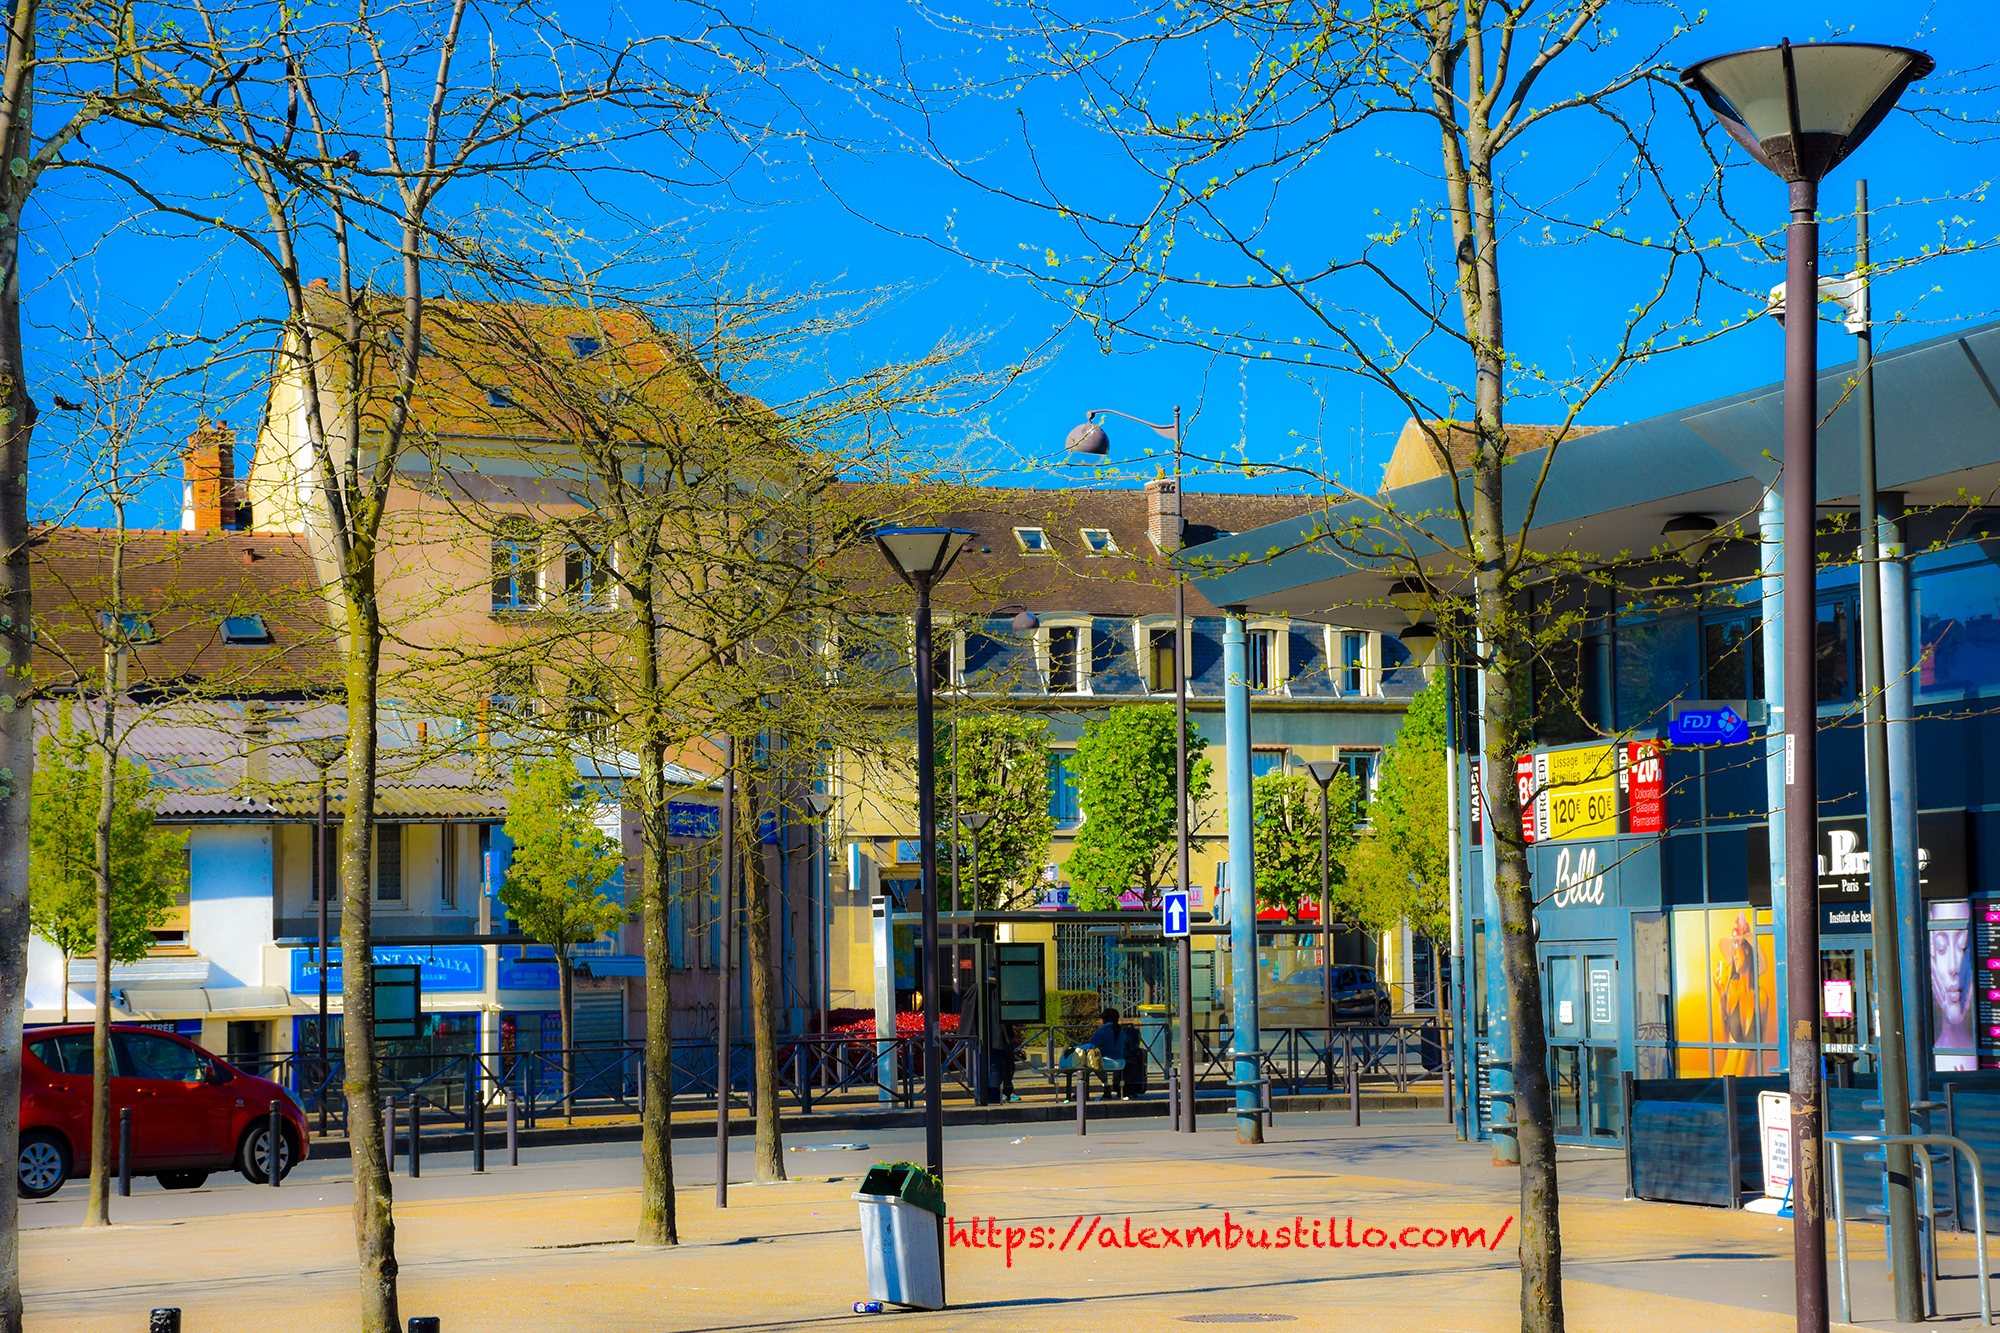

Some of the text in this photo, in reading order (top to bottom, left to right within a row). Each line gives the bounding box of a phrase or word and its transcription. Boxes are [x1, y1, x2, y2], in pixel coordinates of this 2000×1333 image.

[1683, 715, 1712, 729] FDJ
[1552, 756, 1578, 769] Lissage
[1619, 747, 1629, 793] JEUDI
[1471, 766, 1480, 821] MARDI
[1538, 759, 1547, 835] MERCEDI
[1553, 795, 1612, 824] 120€ 60€
[1553, 847, 1605, 908] Belle
[1841, 879, 1860, 892] Paris
[1829, 911, 1850, 924] Institut
[1851, 911, 1860, 922] de
[405, 954, 471, 974] ANTALYA
